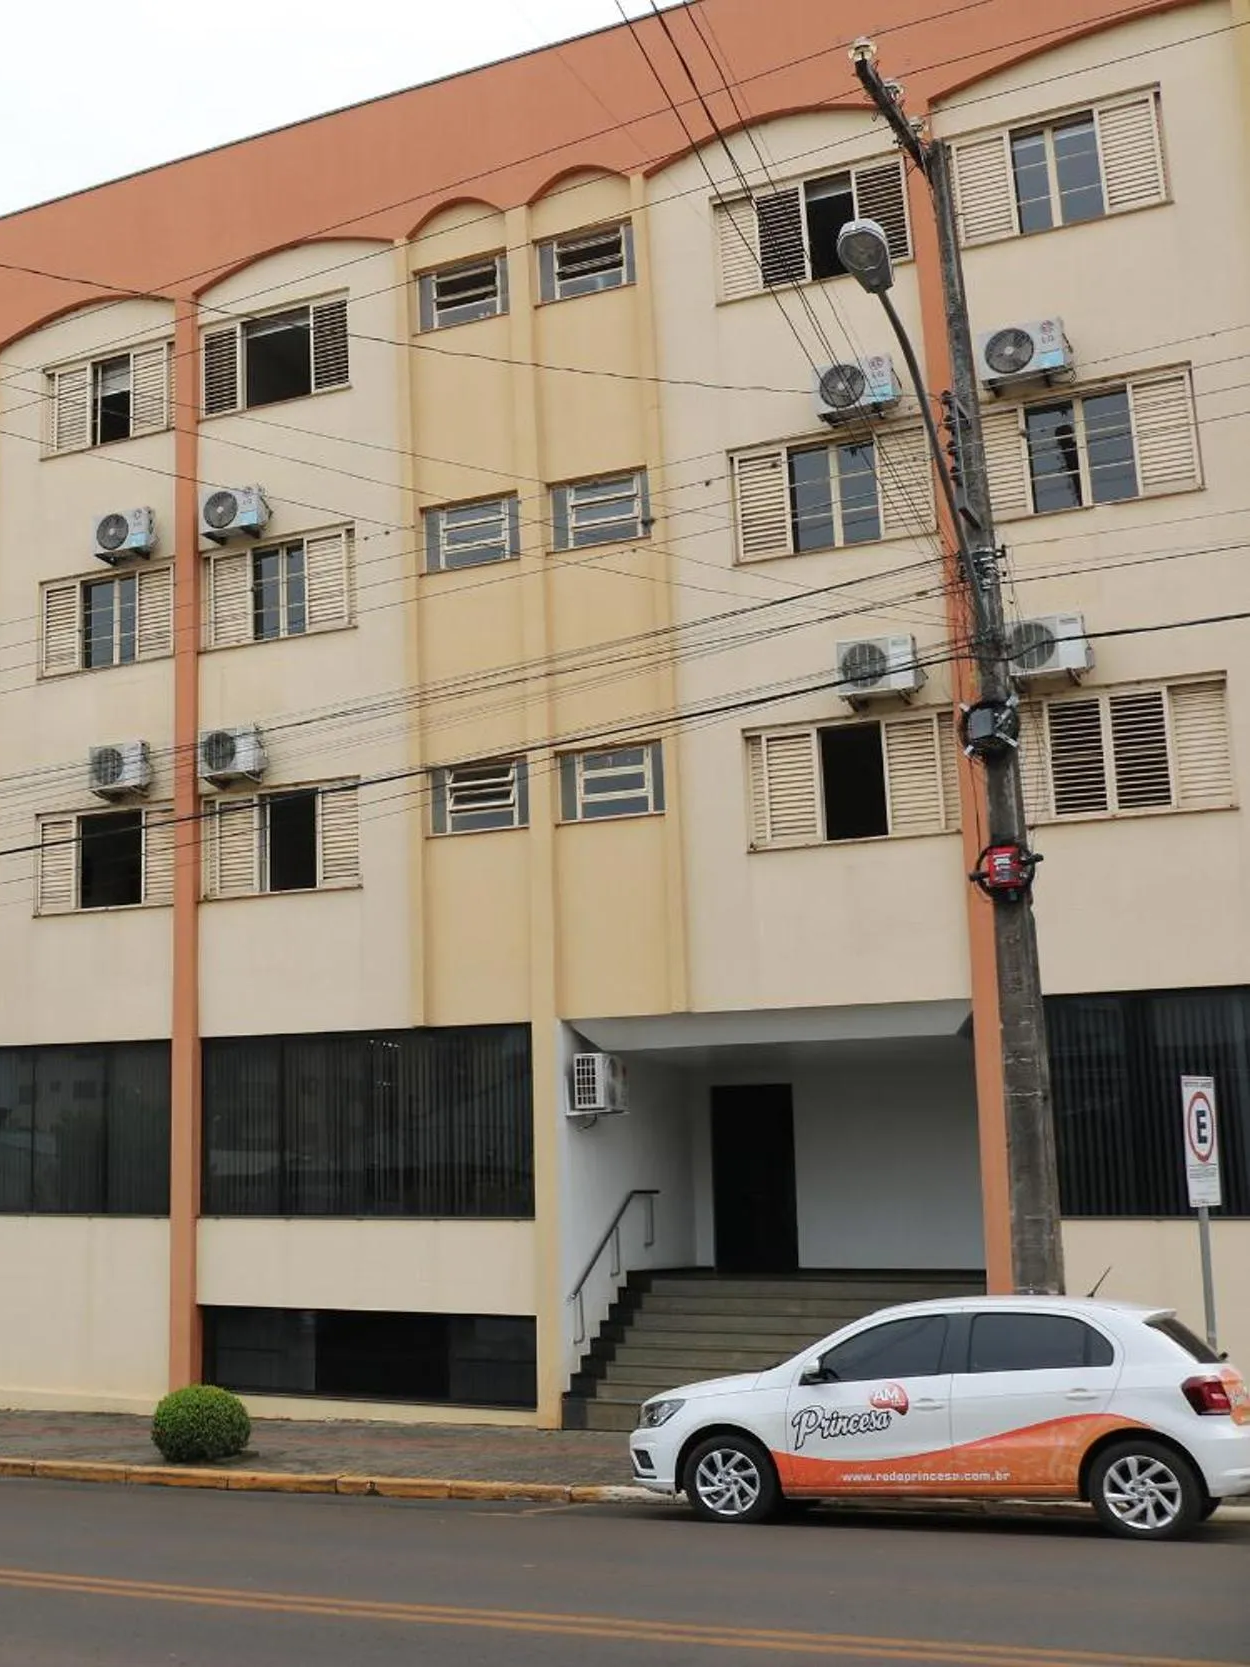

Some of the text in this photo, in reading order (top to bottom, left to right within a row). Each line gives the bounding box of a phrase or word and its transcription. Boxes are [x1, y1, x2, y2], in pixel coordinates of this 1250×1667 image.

[1195, 1109, 1208, 1144] E
[873, 1387, 900, 1401] AM
[791, 1404, 893, 1451] Princesa
